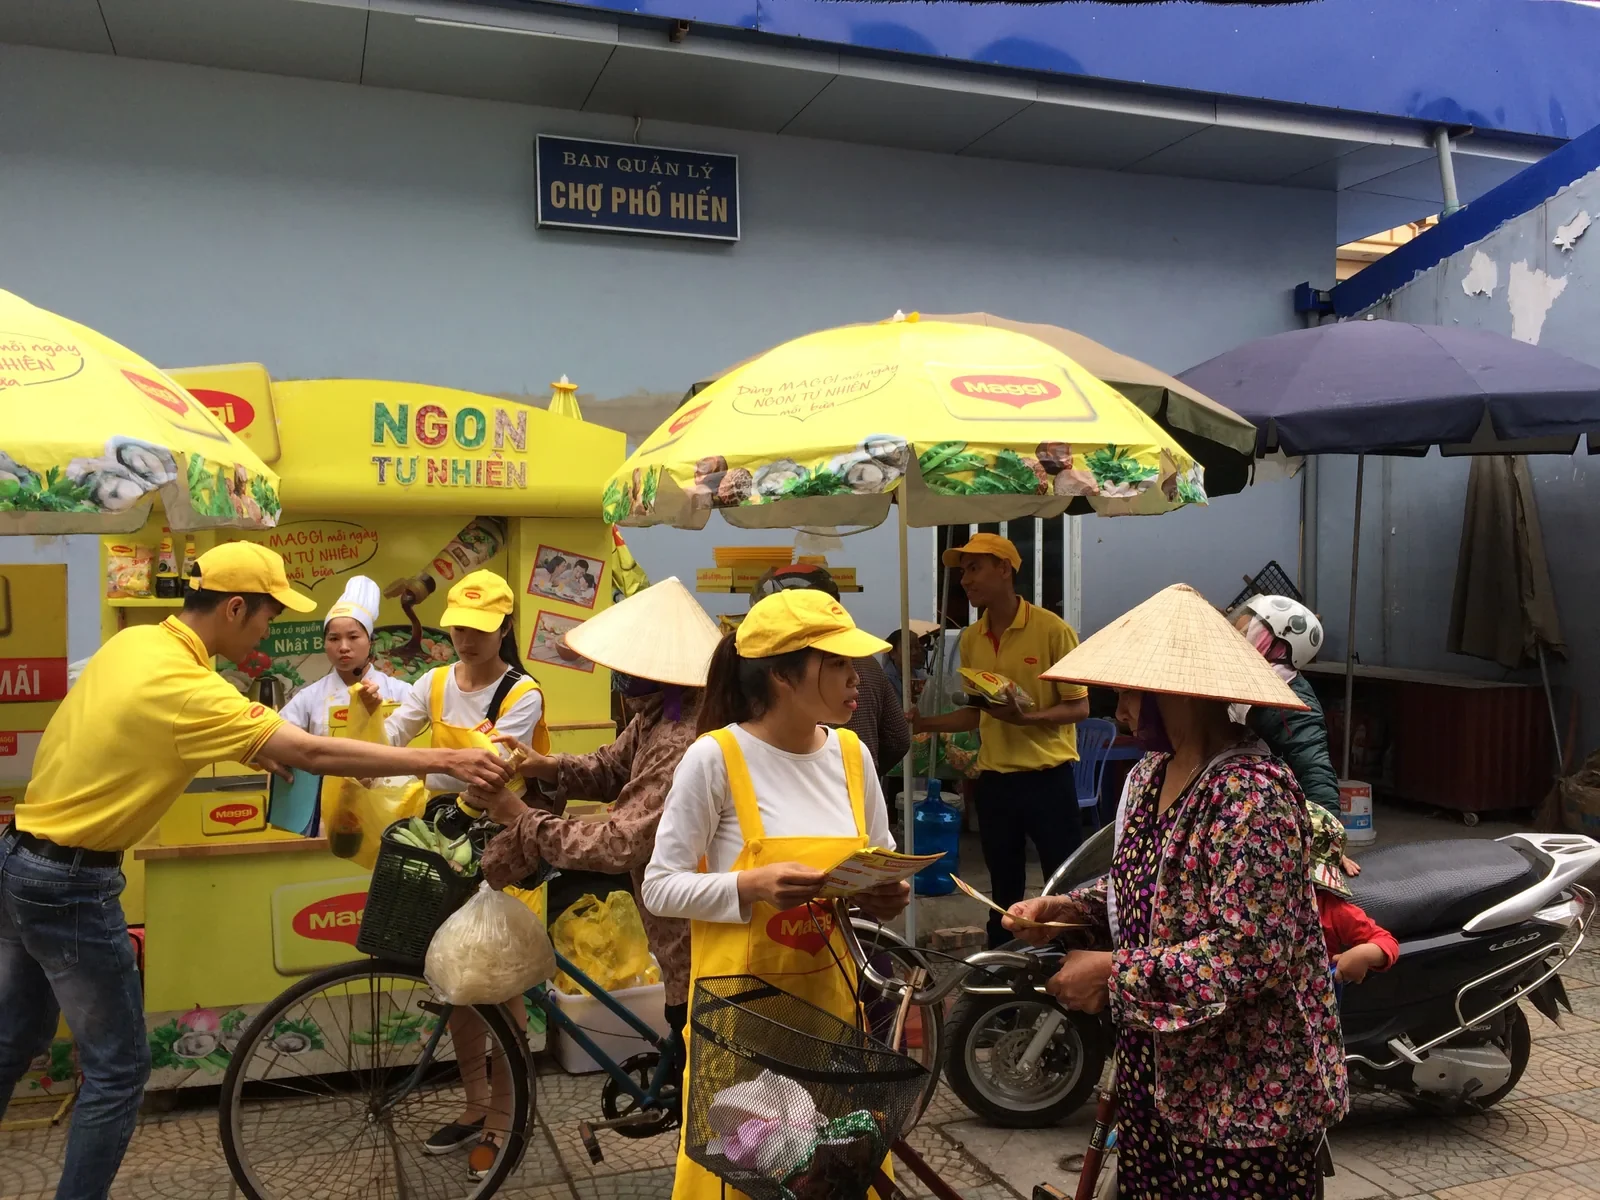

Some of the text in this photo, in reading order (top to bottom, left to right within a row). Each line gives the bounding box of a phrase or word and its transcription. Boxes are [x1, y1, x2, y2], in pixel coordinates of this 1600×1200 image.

[563, 151, 714, 179] BAN QUẢN LÝ
[550, 180, 728, 223] CHỢ PHỐ HIẾN
[0, 354, 56, 372] HIÊN
[778, 374, 838, 392] MAGGI
[962, 381, 1049, 396] Maggi
[753, 394, 796, 409] NGON
[825, 380, 871, 399] NHIÊN
[372, 401, 528, 452] NGON
[426, 451, 528, 489] NHIÊN
[269, 529, 324, 547] MAGGI
[349, 529, 378, 545] ngày
[319, 543, 359, 562] NHIÊN
[274, 637, 309, 654] Nhật
[0, 664, 40, 695] MÃI
[215, 808, 253, 819] Maggi
[780, 913, 833, 937] Magg
